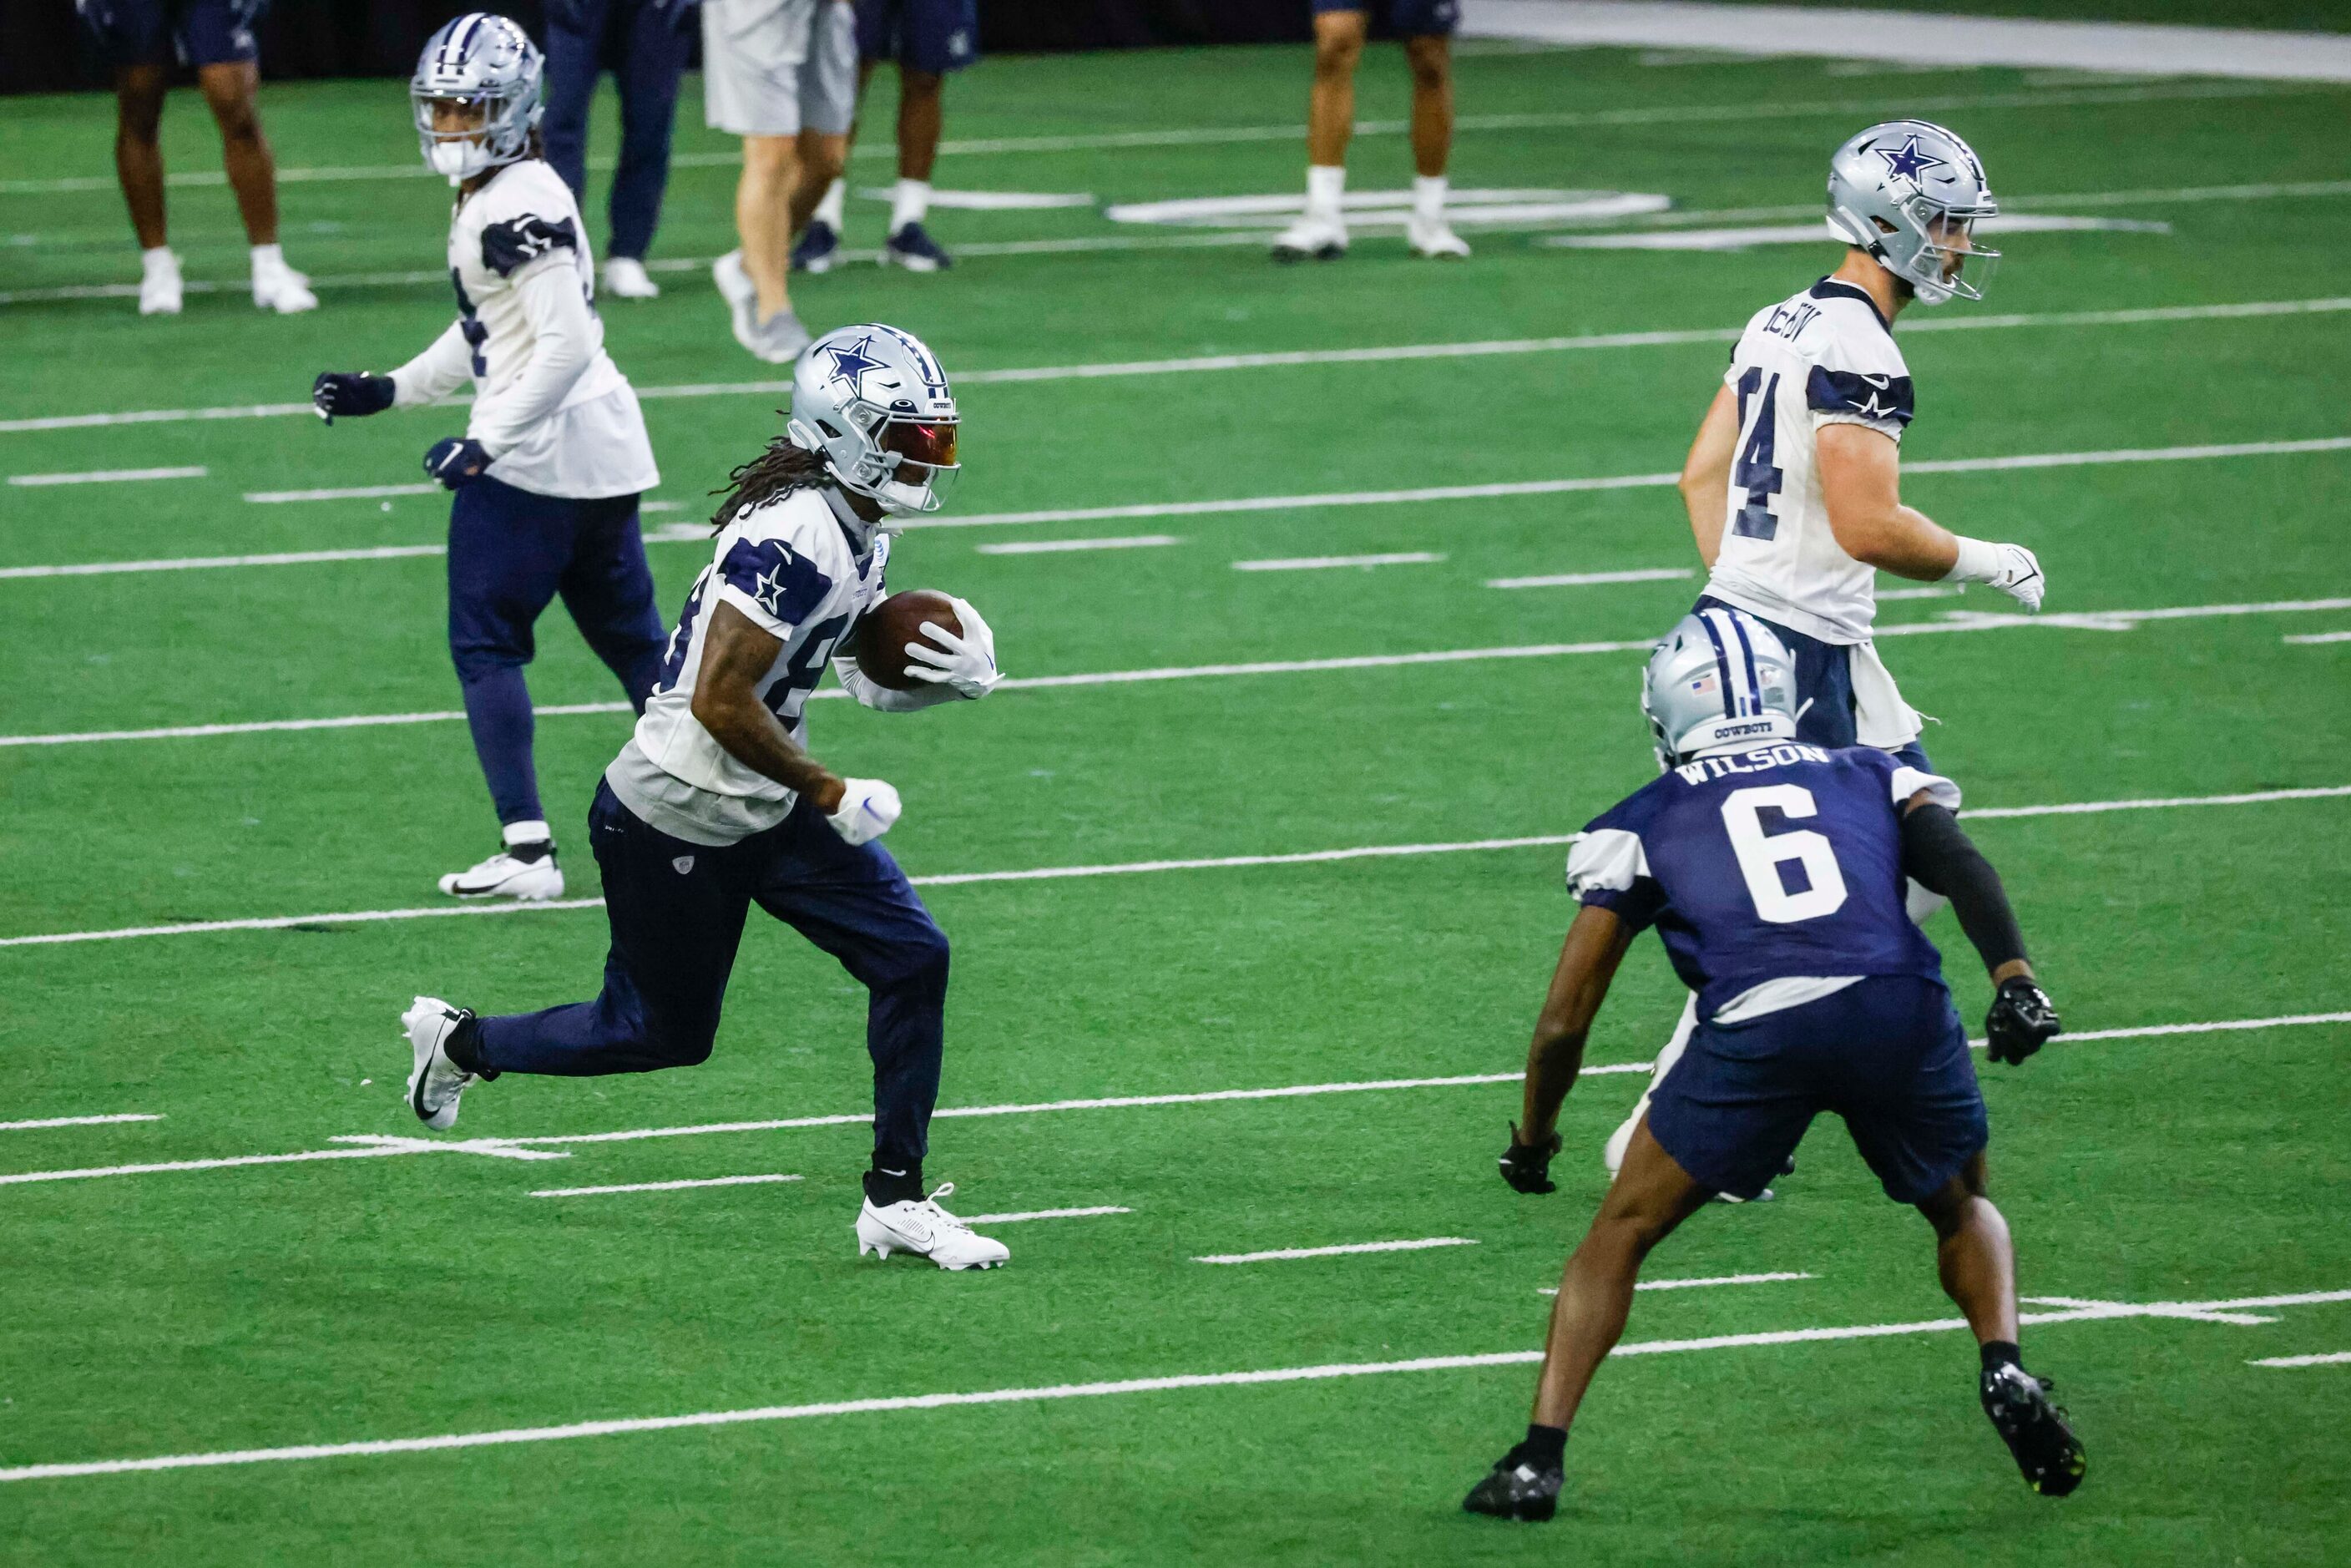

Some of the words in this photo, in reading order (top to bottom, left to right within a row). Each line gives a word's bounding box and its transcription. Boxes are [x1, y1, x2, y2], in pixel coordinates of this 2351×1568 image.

[1714, 721, 1772, 739] COWBOYS
[1674, 745, 1830, 786] WILSON
[1720, 782, 1848, 923] 6
